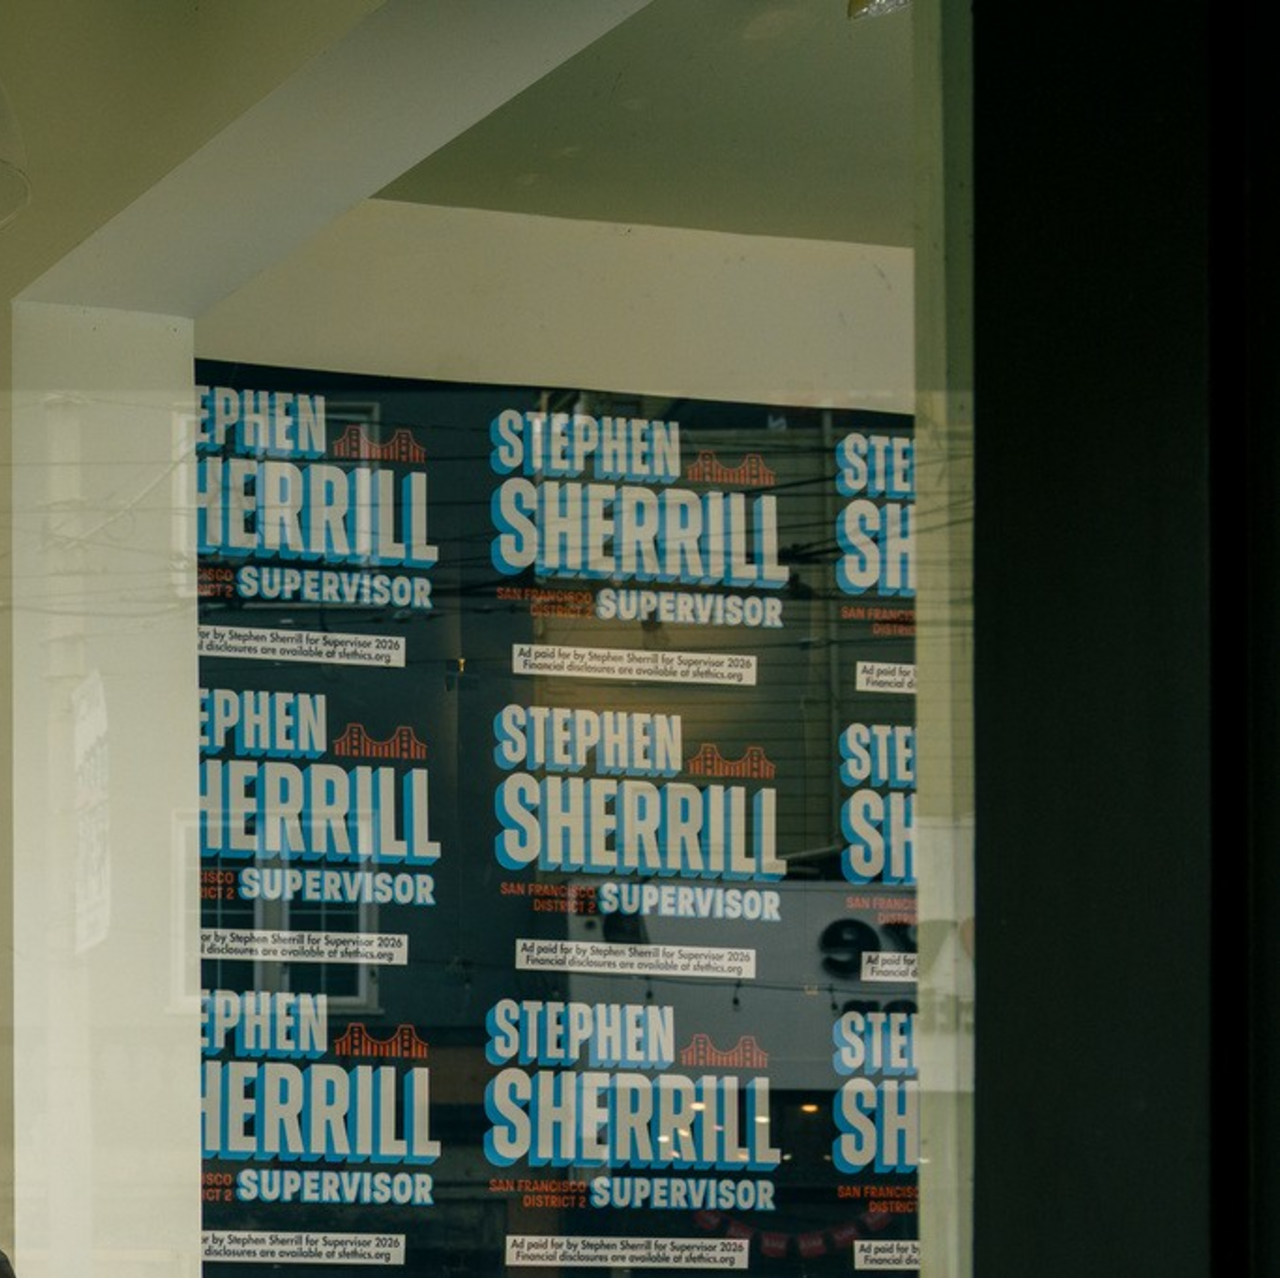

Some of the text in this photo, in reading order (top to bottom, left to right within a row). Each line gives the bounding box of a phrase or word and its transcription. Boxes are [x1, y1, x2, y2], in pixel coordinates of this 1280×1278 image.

[194, 385, 326, 459] EPHEN
[491, 409, 681, 484] STEPHEN
[194, 456, 439, 568] HERRILL
[491, 476, 790, 590] SHERRILL
[236, 566, 433, 608] SUPERVISOR
[596, 588, 783, 627] SUPERVISOR
[207, 642, 257, 654] disclosures
[280, 646, 323, 657] available
[326, 649, 337, 658] at
[339, 650, 390, 664] sfethics.org
[214, 630, 400, 650] by Stephen Sherrill for Supervisor 2026
[518, 648, 752, 669] Ad paid for by Stephen Sherrill for Supervisor 2026
[523, 660, 564, 670] Financial
[567, 663, 616, 674] disclosures
[636, 666, 677, 676] available
[681, 669, 690, 677] at
[692, 669, 743, 682] sfethics.org
[495, 704, 683, 778] STEPHEN
[199, 760, 441, 865] HERRILL
[495, 772, 787, 882] SHERRILL
[239, 868, 435, 905] SUPERVISOR
[600, 883, 780, 920] SUPERVISOR
[521, 943, 750, 963] Ad paid for by Stephen Sherrill for Supervisor 2026
[526, 955, 566, 965] Financial
[568, 958, 617, 968] disclosures
[637, 961, 678, 971] available
[681, 962, 691, 971] at
[693, 962, 742, 976] sfethics.org
[486, 997, 675, 1070] STEPHEN
[202, 1060, 441, 1165] HERRILL
[484, 1068, 782, 1172] SHERRILL
[237, 1169, 433, 1205] SUPERVISOR
[523, 1195, 576, 1207] DISTRICT
[590, 1176, 775, 1210] SUPERVISOR
[205, 1247, 257, 1256] disclosures
[279, 1248, 323, 1258] available
[326, 1249, 336, 1258] at
[338, 1249, 390, 1263] sfethics.org
[212, 1235, 400, 1250] by Stephen Sherrill for Supervisor 2026
[512, 1240, 744, 1254] Ad paid for by Stephen Sherrill for Supervisor 2026
[516, 1251, 557, 1261] Financial
[559, 1252, 608, 1262] disclosures
[629, 1253, 670, 1263] available
[673, 1253, 683, 1263] at
[685, 1253, 735, 1266] sfethics.org
